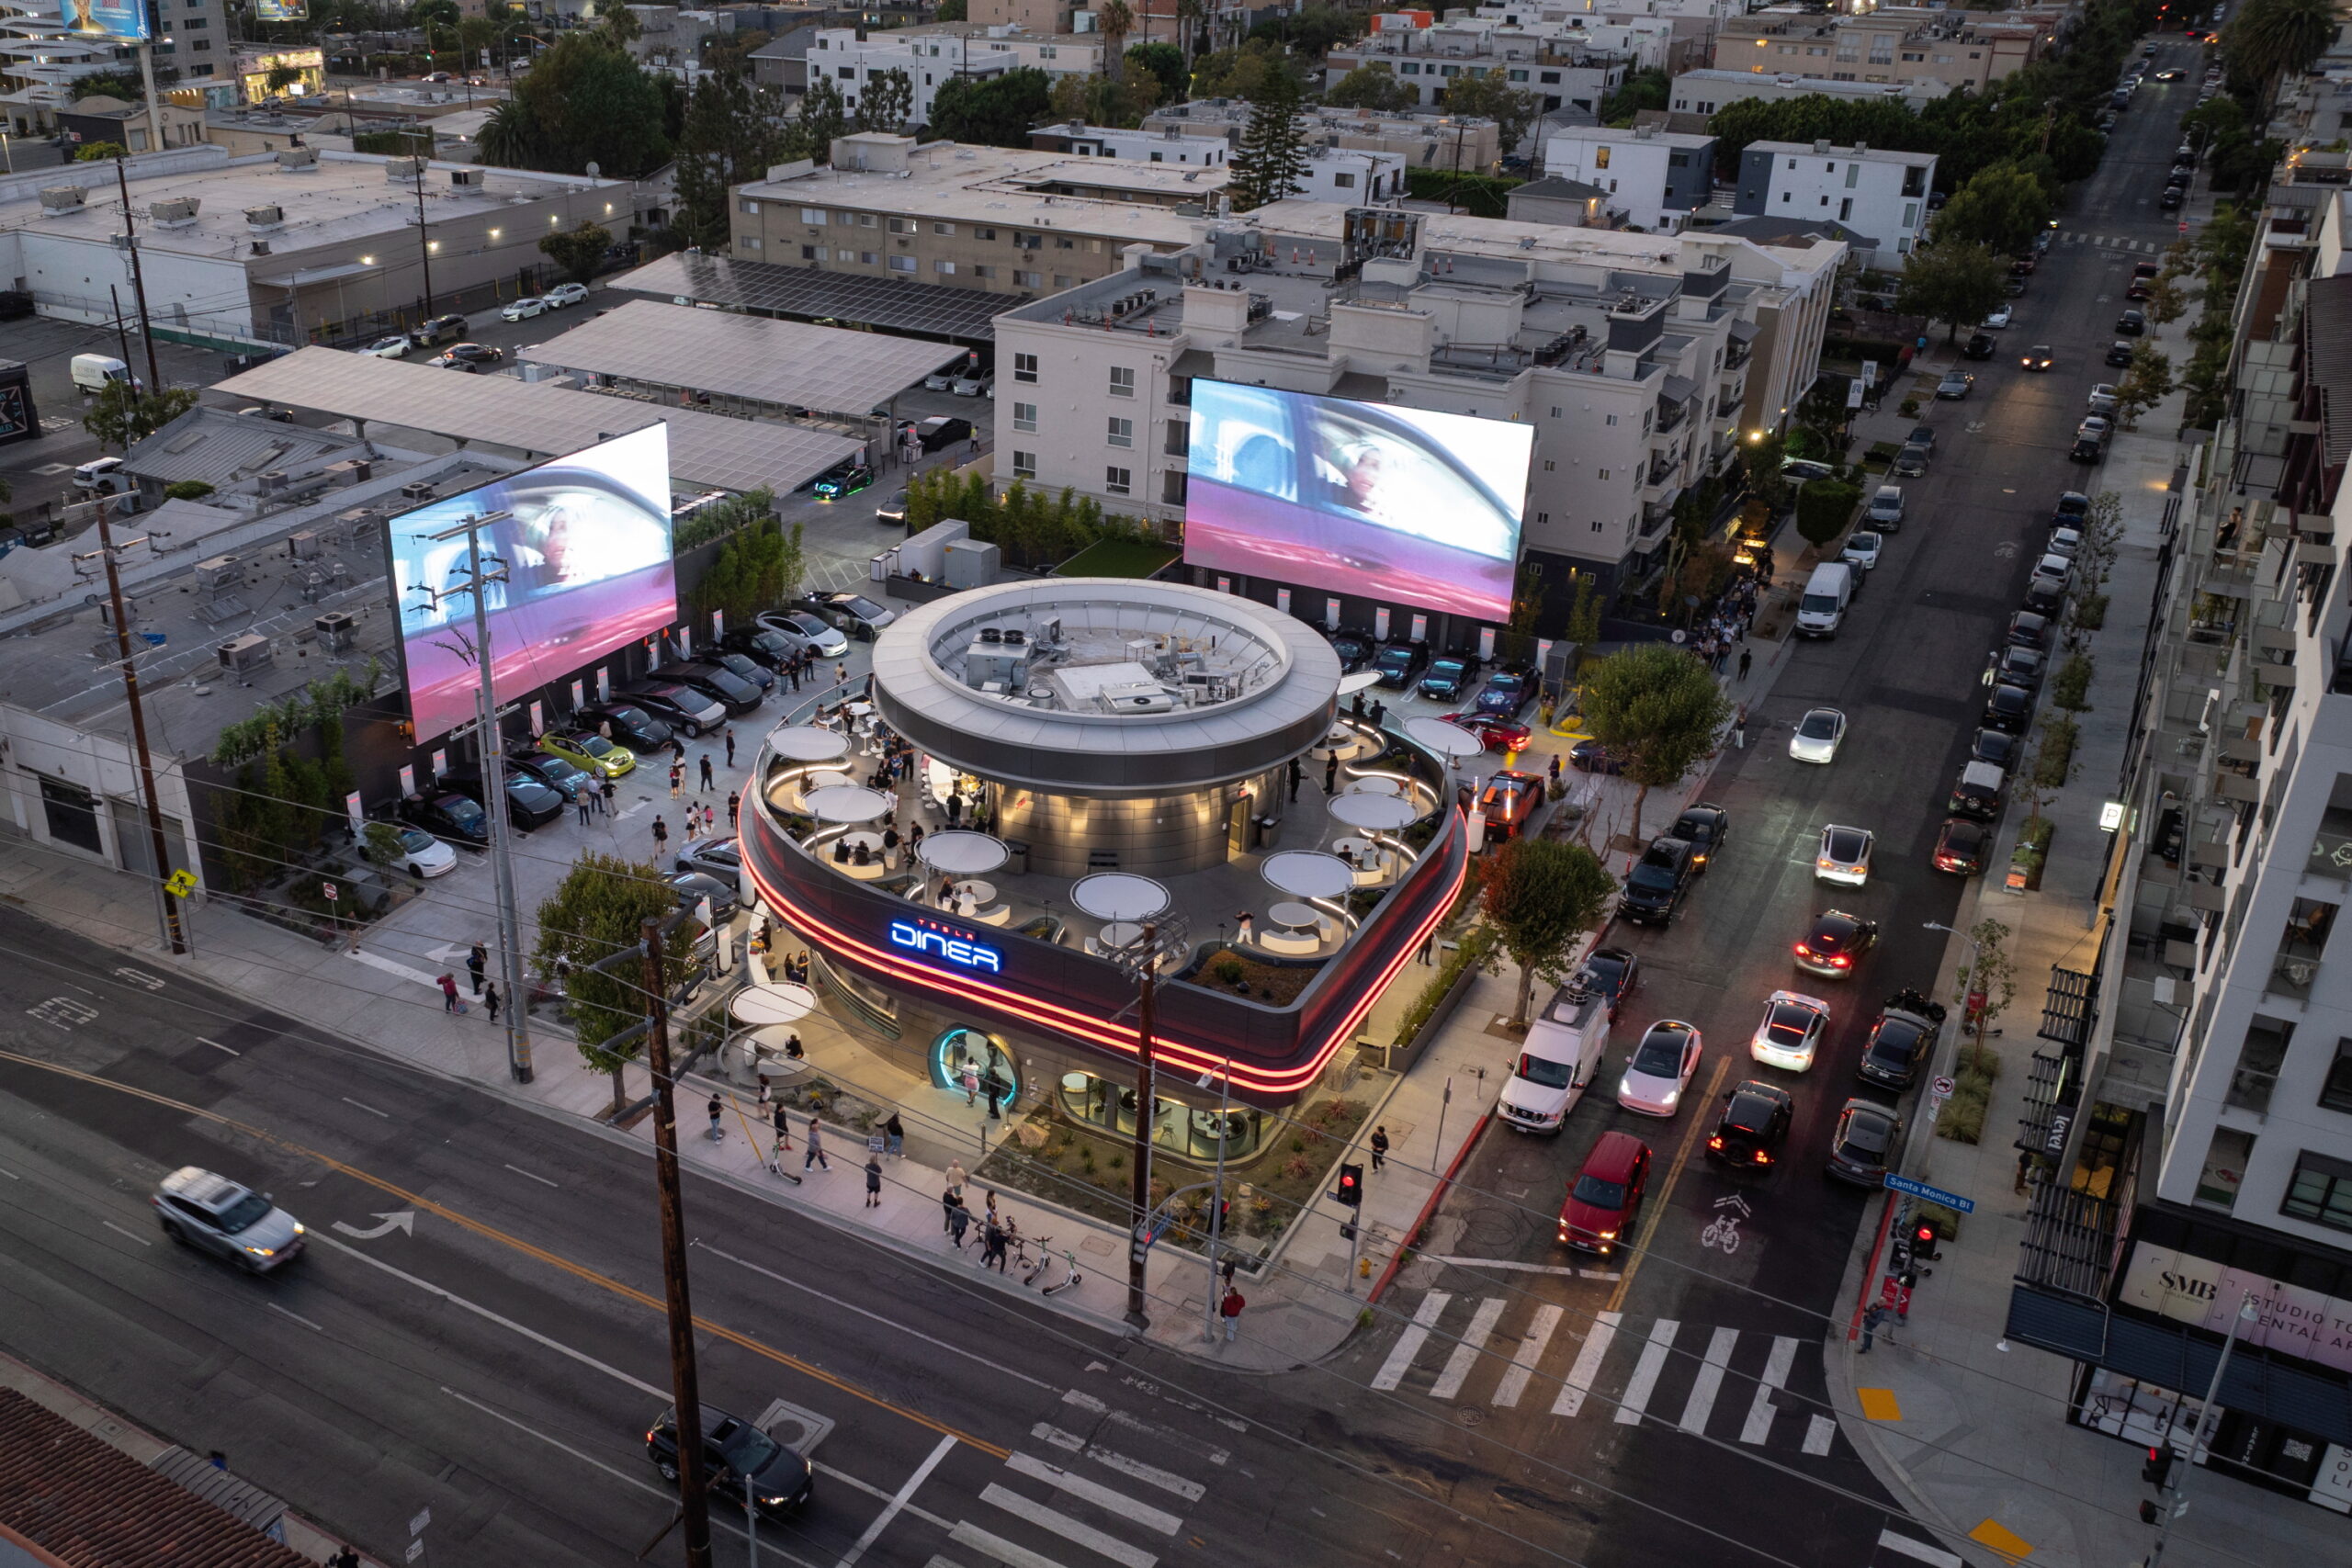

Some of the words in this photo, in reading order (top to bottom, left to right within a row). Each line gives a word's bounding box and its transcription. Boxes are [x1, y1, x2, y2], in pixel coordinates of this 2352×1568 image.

[2106, 808, 2119, 822] P
[919, 919, 974, 941] TESLA
[892, 922, 999, 972] DINER
[2048, 1115, 2071, 1150] level
[1889, 1177, 1919, 1193] Santa
[1920, 1186, 1957, 1205] Monica
[2159, 1270, 2217, 1301] SMB
[2250, 1294, 2324, 1325] STUDIO
[2258, 1314, 2322, 1343] ENTAL
